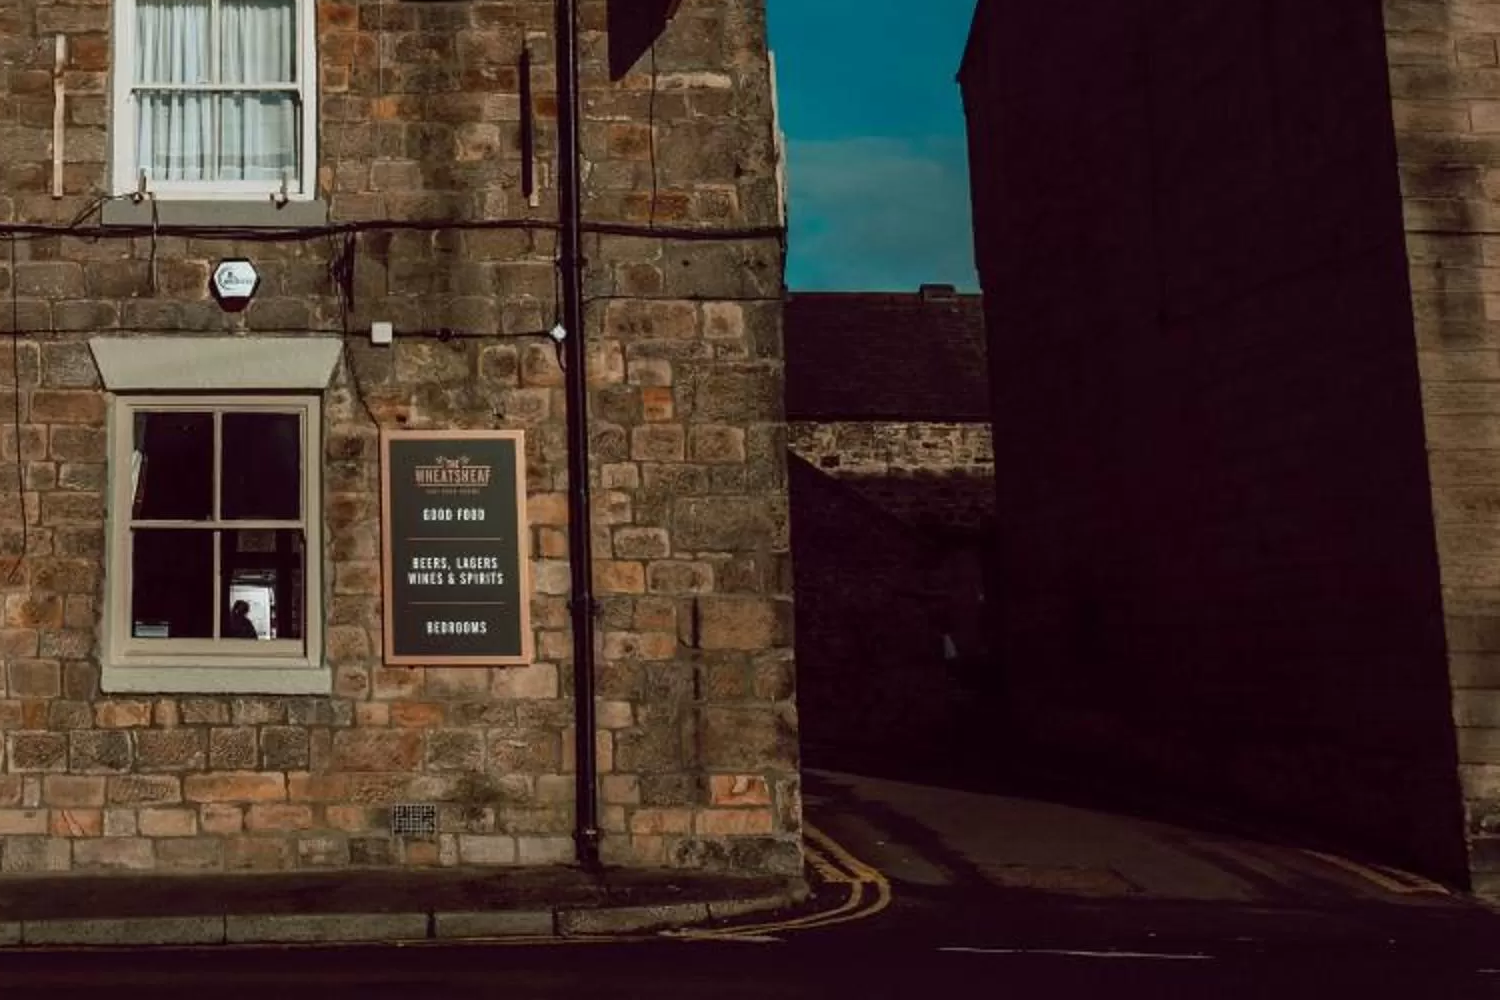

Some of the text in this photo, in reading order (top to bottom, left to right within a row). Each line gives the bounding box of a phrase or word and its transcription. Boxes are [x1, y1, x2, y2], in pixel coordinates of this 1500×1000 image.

[415, 469, 491, 483] WHEATSHEAF
[423, 507, 485, 521] GOOD FOOD
[412, 557, 498, 571] BEERS, LAGERS
[407, 572, 504, 585] WINES & SPIRITS
[426, 621, 487, 635] BEDROOMS
